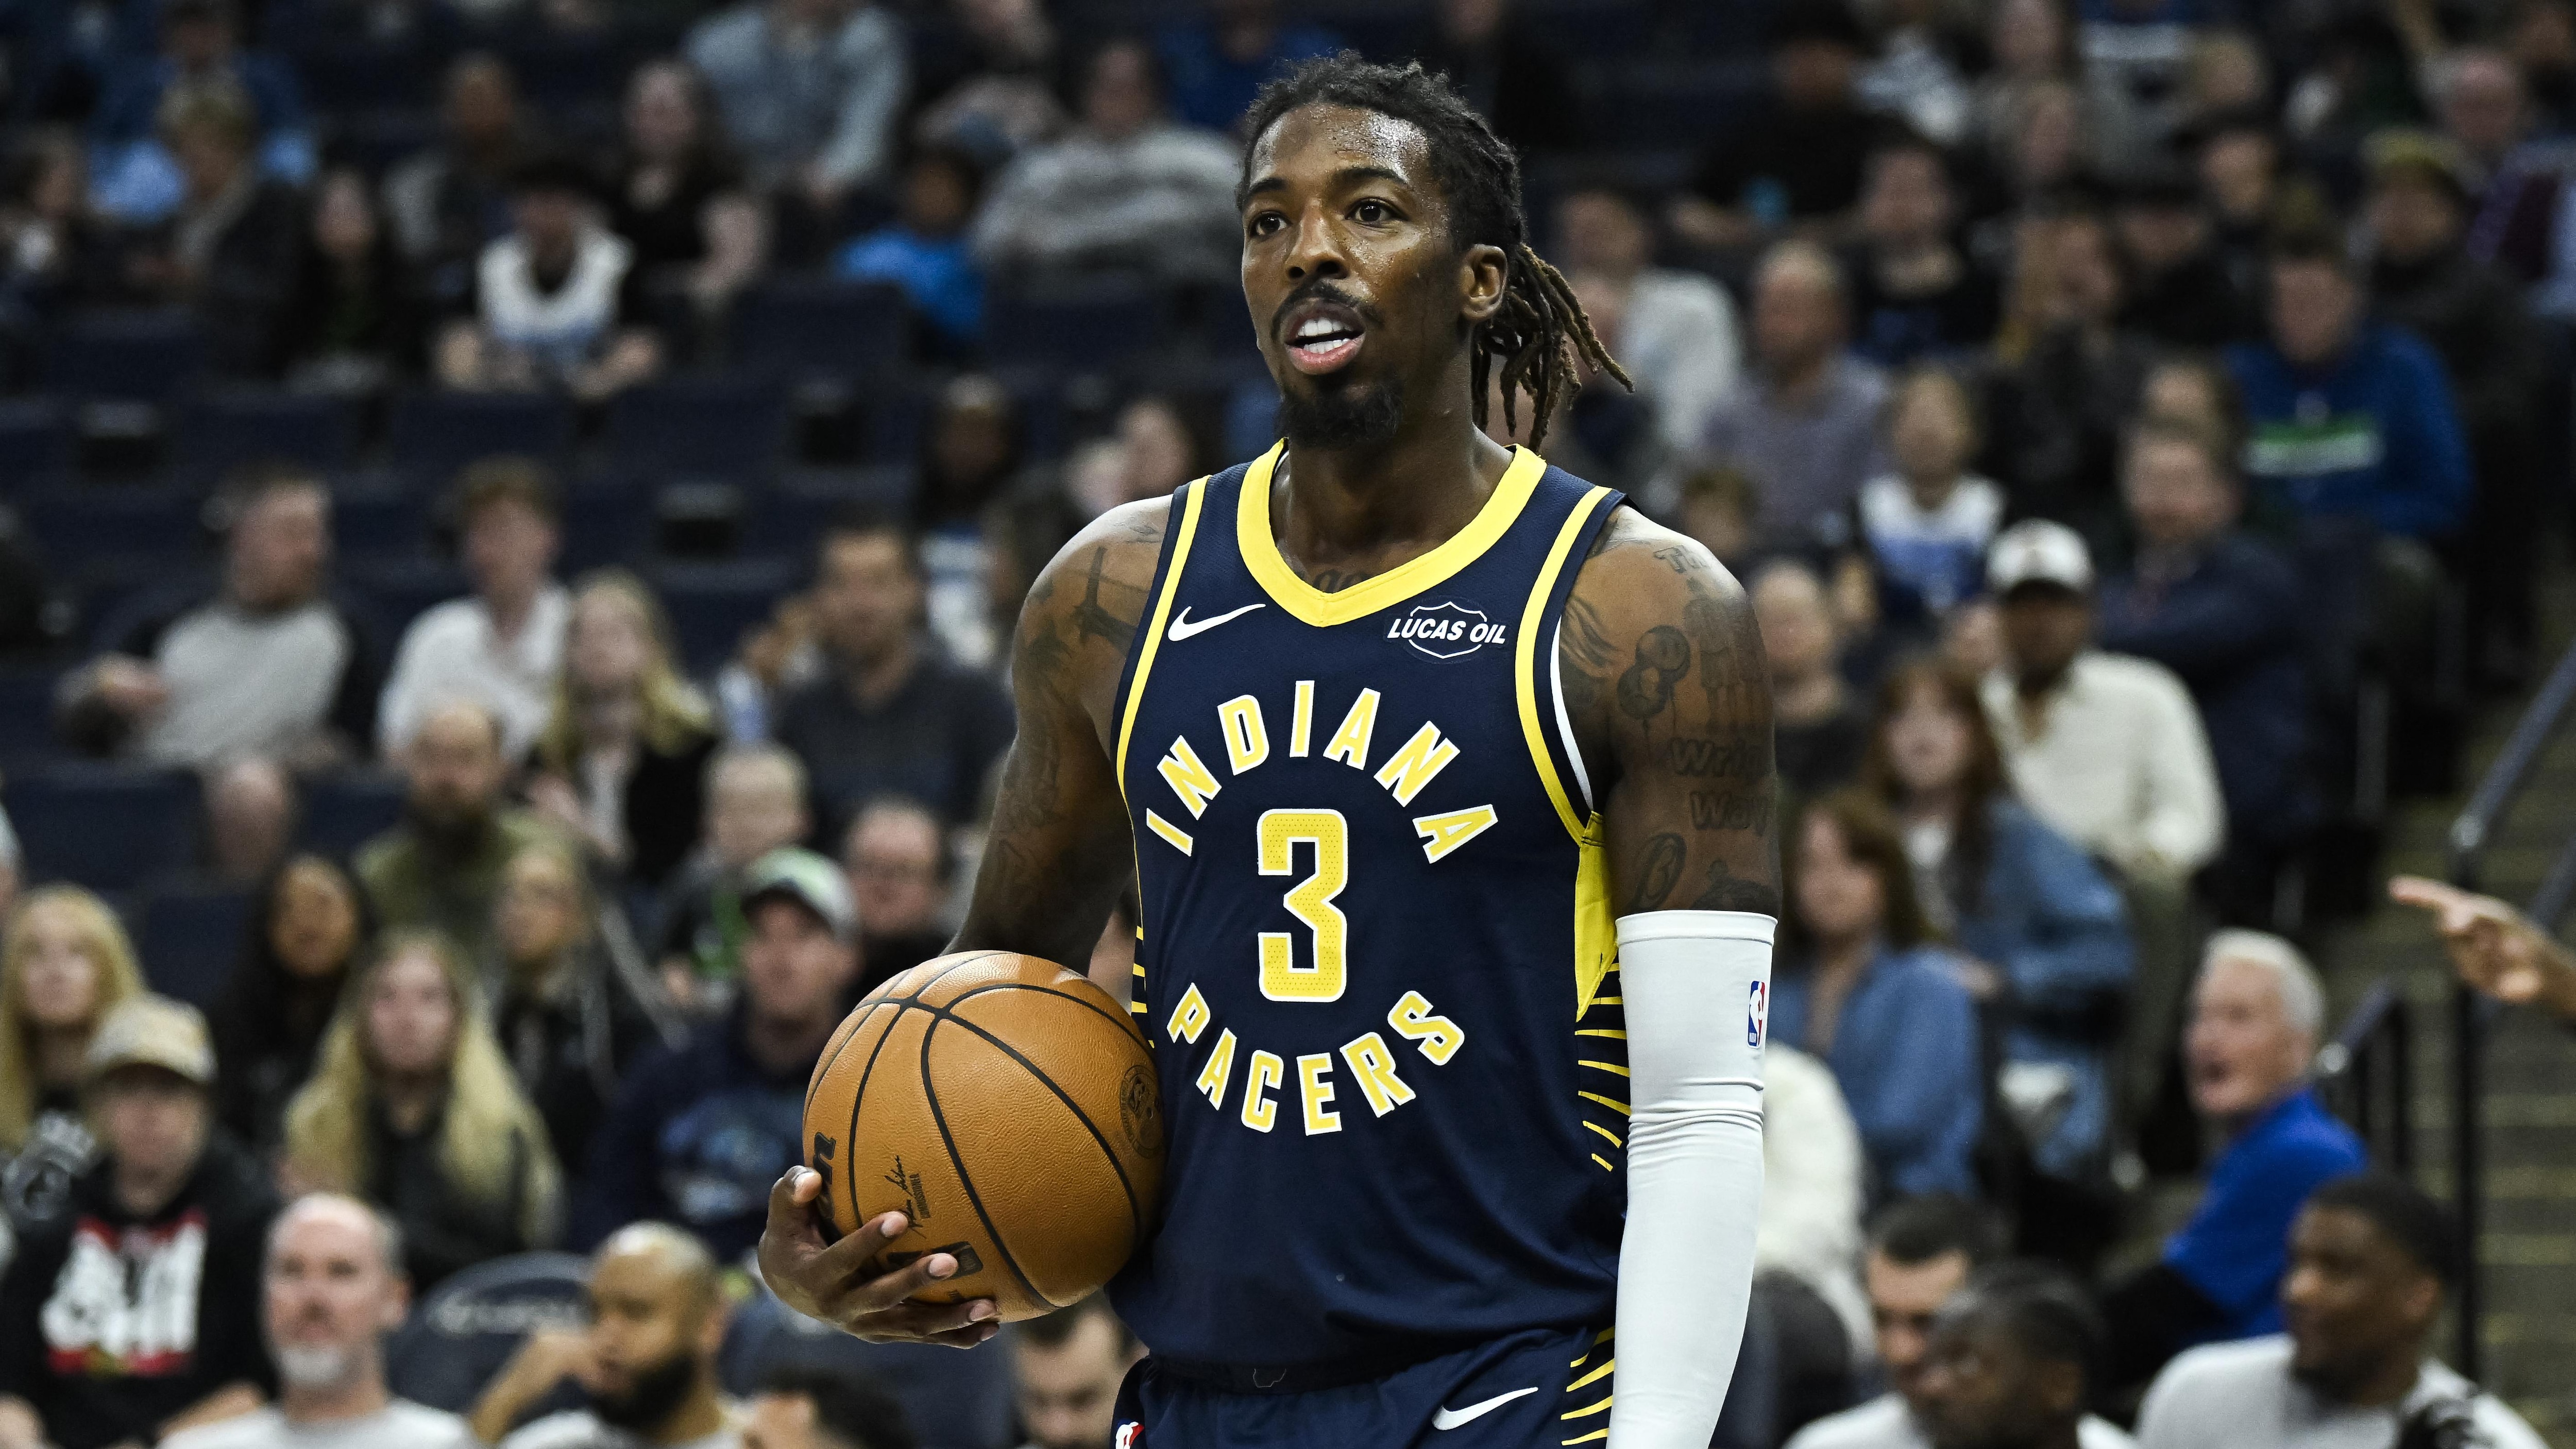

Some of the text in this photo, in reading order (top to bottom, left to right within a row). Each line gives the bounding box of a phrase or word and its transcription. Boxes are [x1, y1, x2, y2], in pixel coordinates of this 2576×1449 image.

[1387, 618, 1506, 644] LUCAS OIL
[1146, 680, 1498, 864] INDIANA
[1257, 808, 1348, 1002] 3
[1167, 982, 1465, 1136] PACERS
